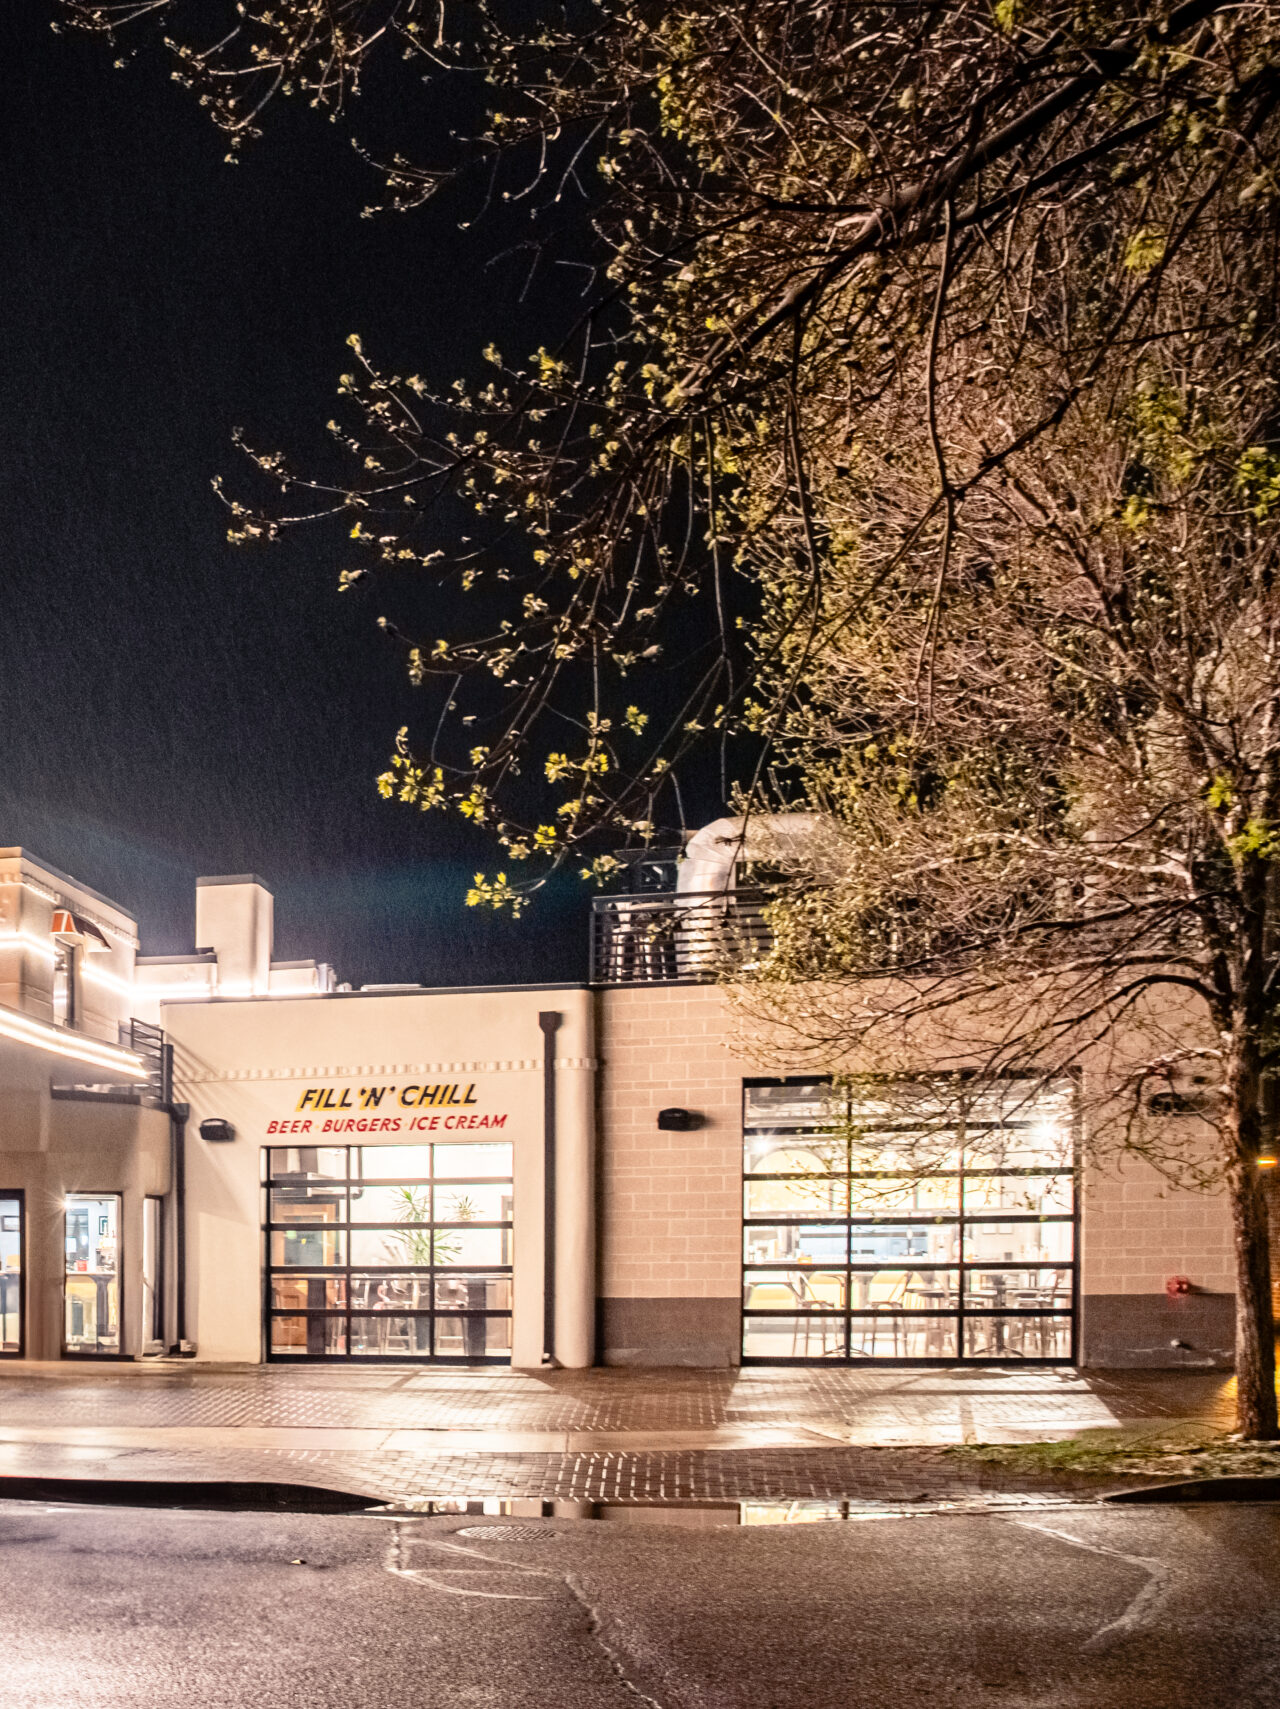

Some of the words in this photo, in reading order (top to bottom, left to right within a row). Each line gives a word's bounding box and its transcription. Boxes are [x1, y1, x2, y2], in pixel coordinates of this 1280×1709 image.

[296, 1088, 353, 1112] FILL
[398, 1083, 478, 1108] CHILL
[266, 1120, 313, 1134] BEER
[321, 1118, 402, 1133] BURGERS
[409, 1116, 441, 1131] ICE
[444, 1114, 508, 1130] CREAM
